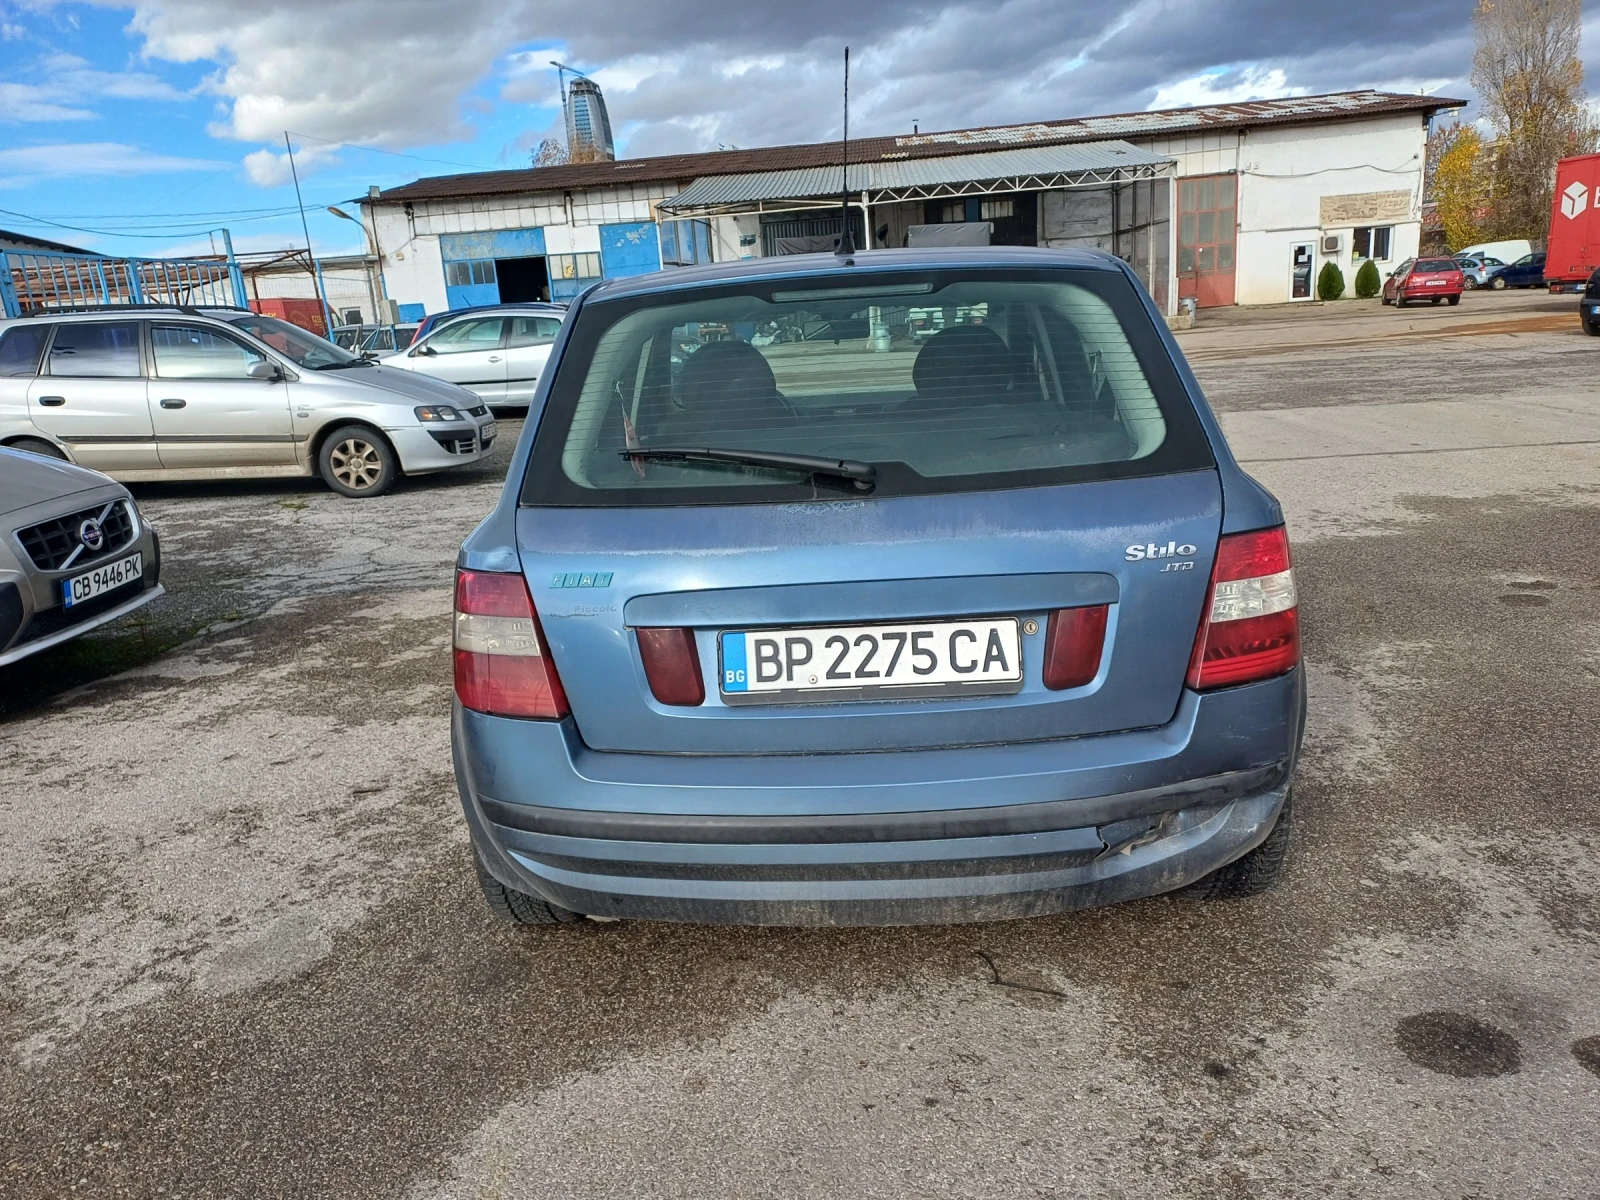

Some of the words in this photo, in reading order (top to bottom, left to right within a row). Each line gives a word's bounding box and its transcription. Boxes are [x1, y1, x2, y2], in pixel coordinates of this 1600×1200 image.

[1124, 541, 1197, 562] Stilo
[1159, 561, 1194, 573] JTD
[73, 576, 91, 600] CB
[93, 563, 123, 593] 9446
[124, 556, 140, 580] PK
[552, 573, 609, 586] FIAT
[754, 637, 813, 683] BP
[824, 631, 938, 680] 2275
[949, 628, 1010, 674] CA
[725, 669, 745, 684] BG
